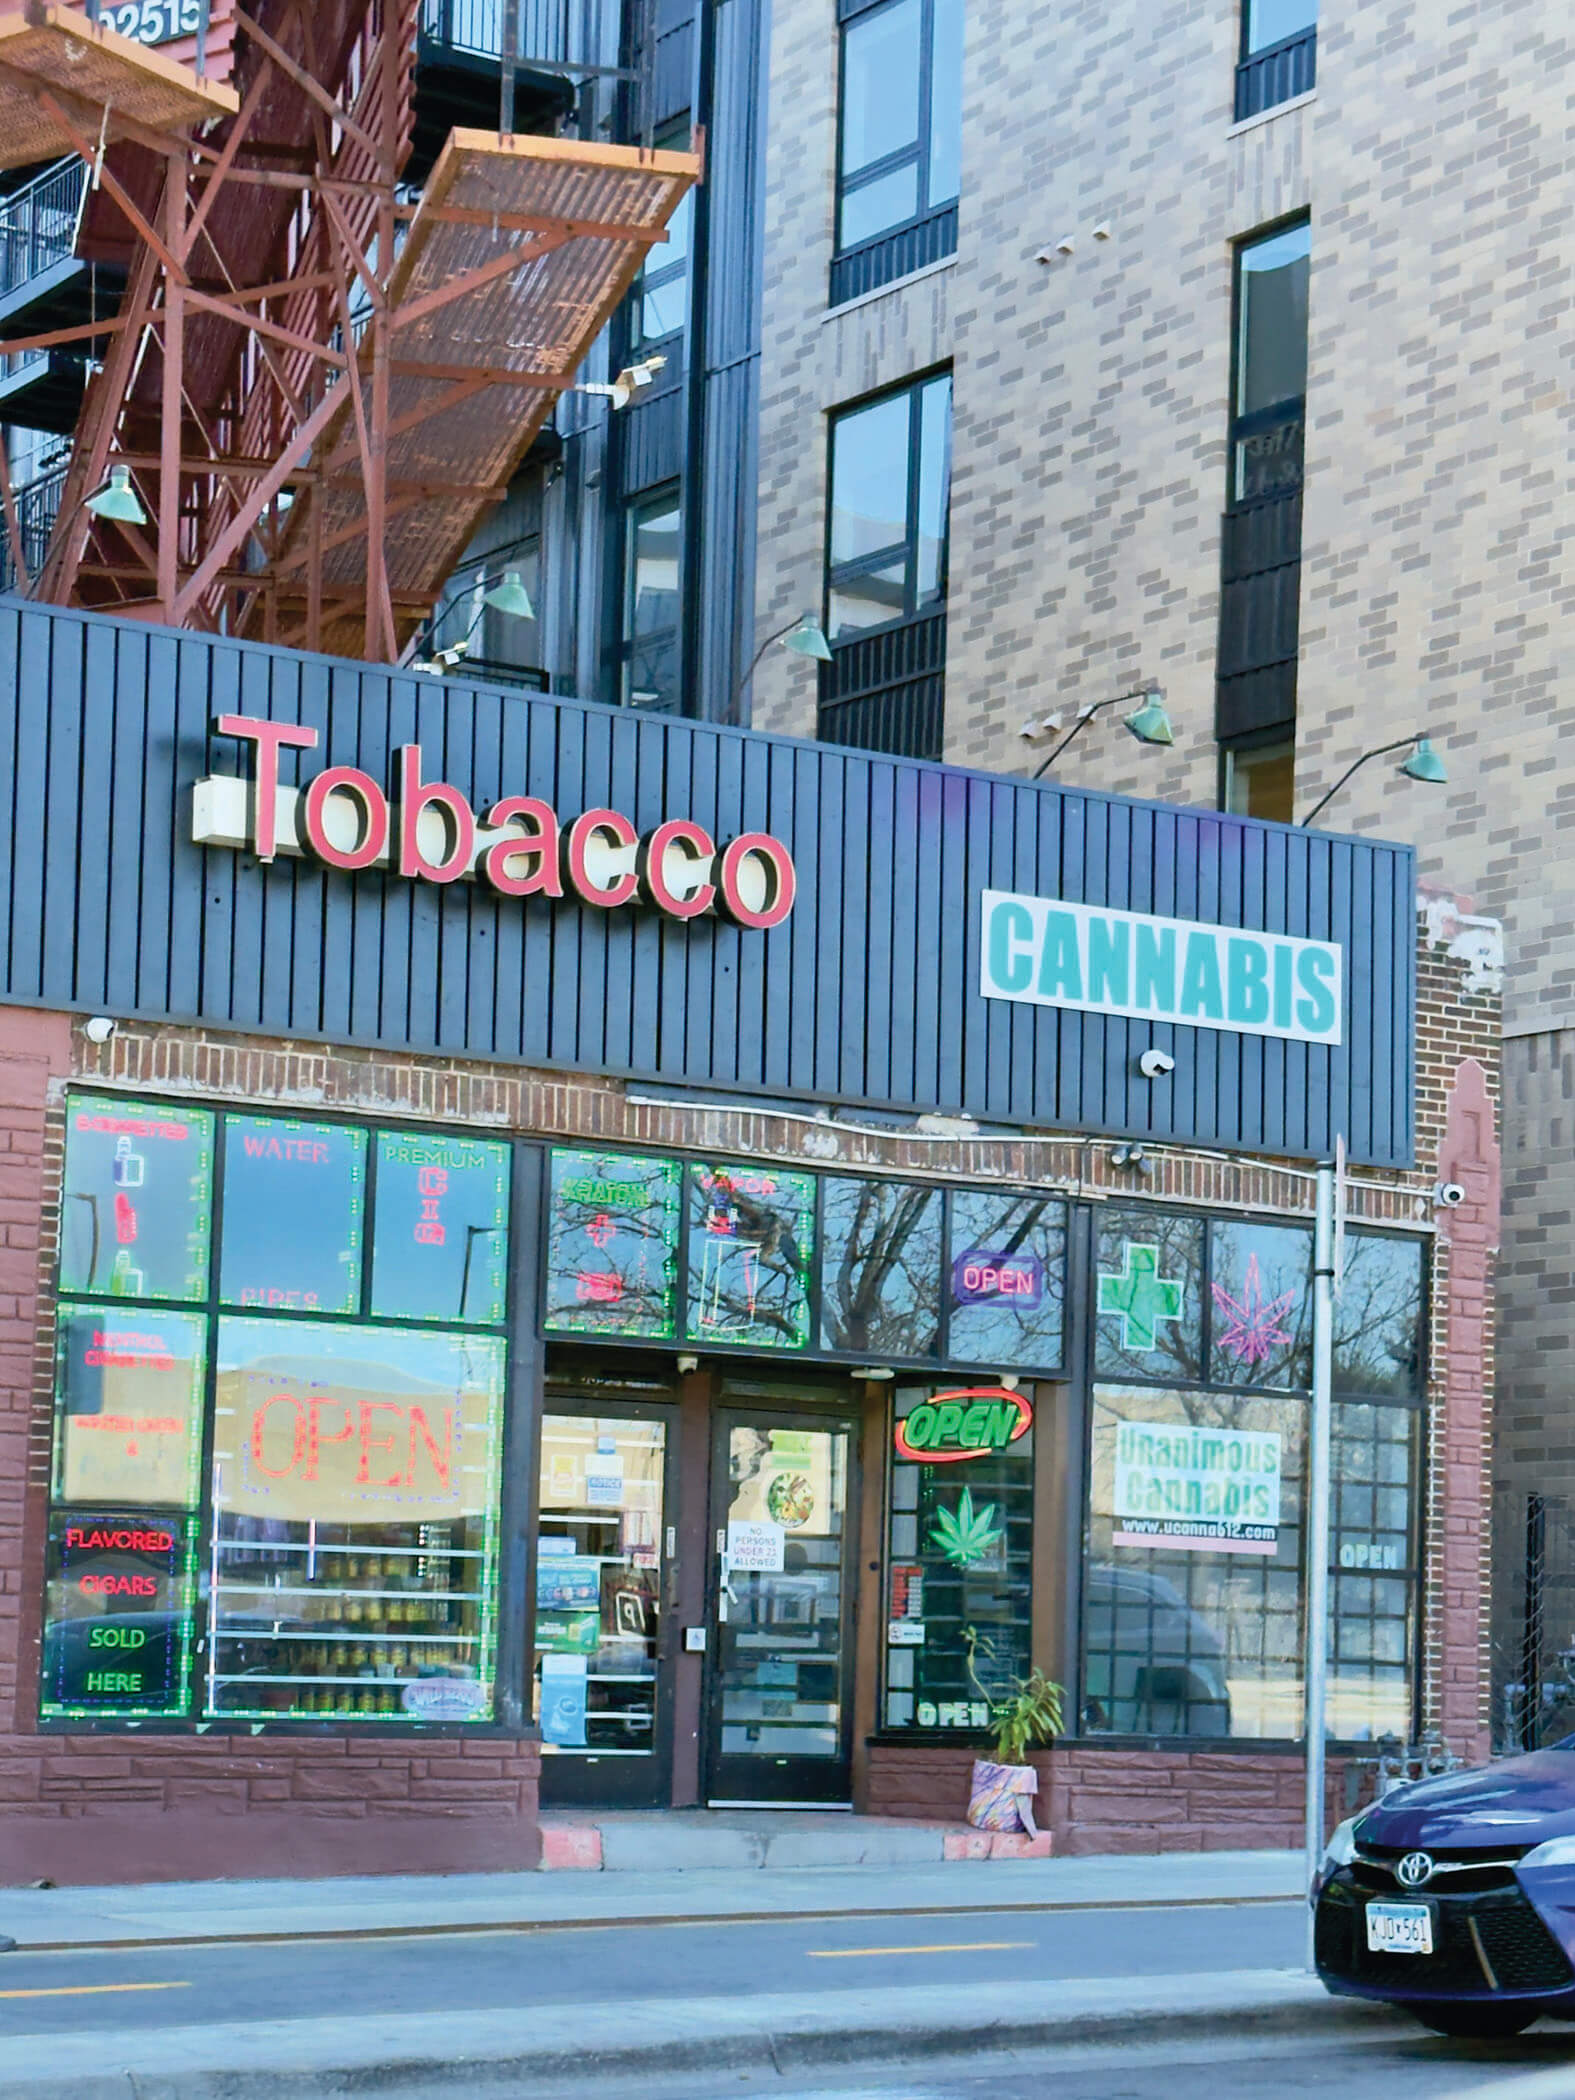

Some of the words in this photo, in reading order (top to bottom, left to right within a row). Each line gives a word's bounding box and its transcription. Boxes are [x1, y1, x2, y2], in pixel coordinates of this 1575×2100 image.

[217, 714, 796, 929] Tobacco
[988, 902, 1335, 1033] CANNABIS
[243, 1135, 330, 1164] WATER
[385, 1146, 485, 1170] PREMIUM
[963, 1266, 1034, 1295] OPEN
[904, 1404, 1018, 1447] OPEN
[252, 1393, 454, 1489] OPEN
[1120, 1428, 1277, 1473] Unanimous
[1126, 1471, 1270, 1518] Cannabis
[66, 1528, 174, 1550] FLAVORED
[1121, 1519, 1276, 1540] www.ucanna612.com
[735, 1557, 777, 1567] ALLOWED
[1339, 1544, 1397, 1569] OPEN
[79, 1575, 157, 1596] CIGARS
[89, 1628, 145, 1648] SOLD
[87, 1672, 142, 1692] HERE
[917, 1701, 989, 1727] OPEN
